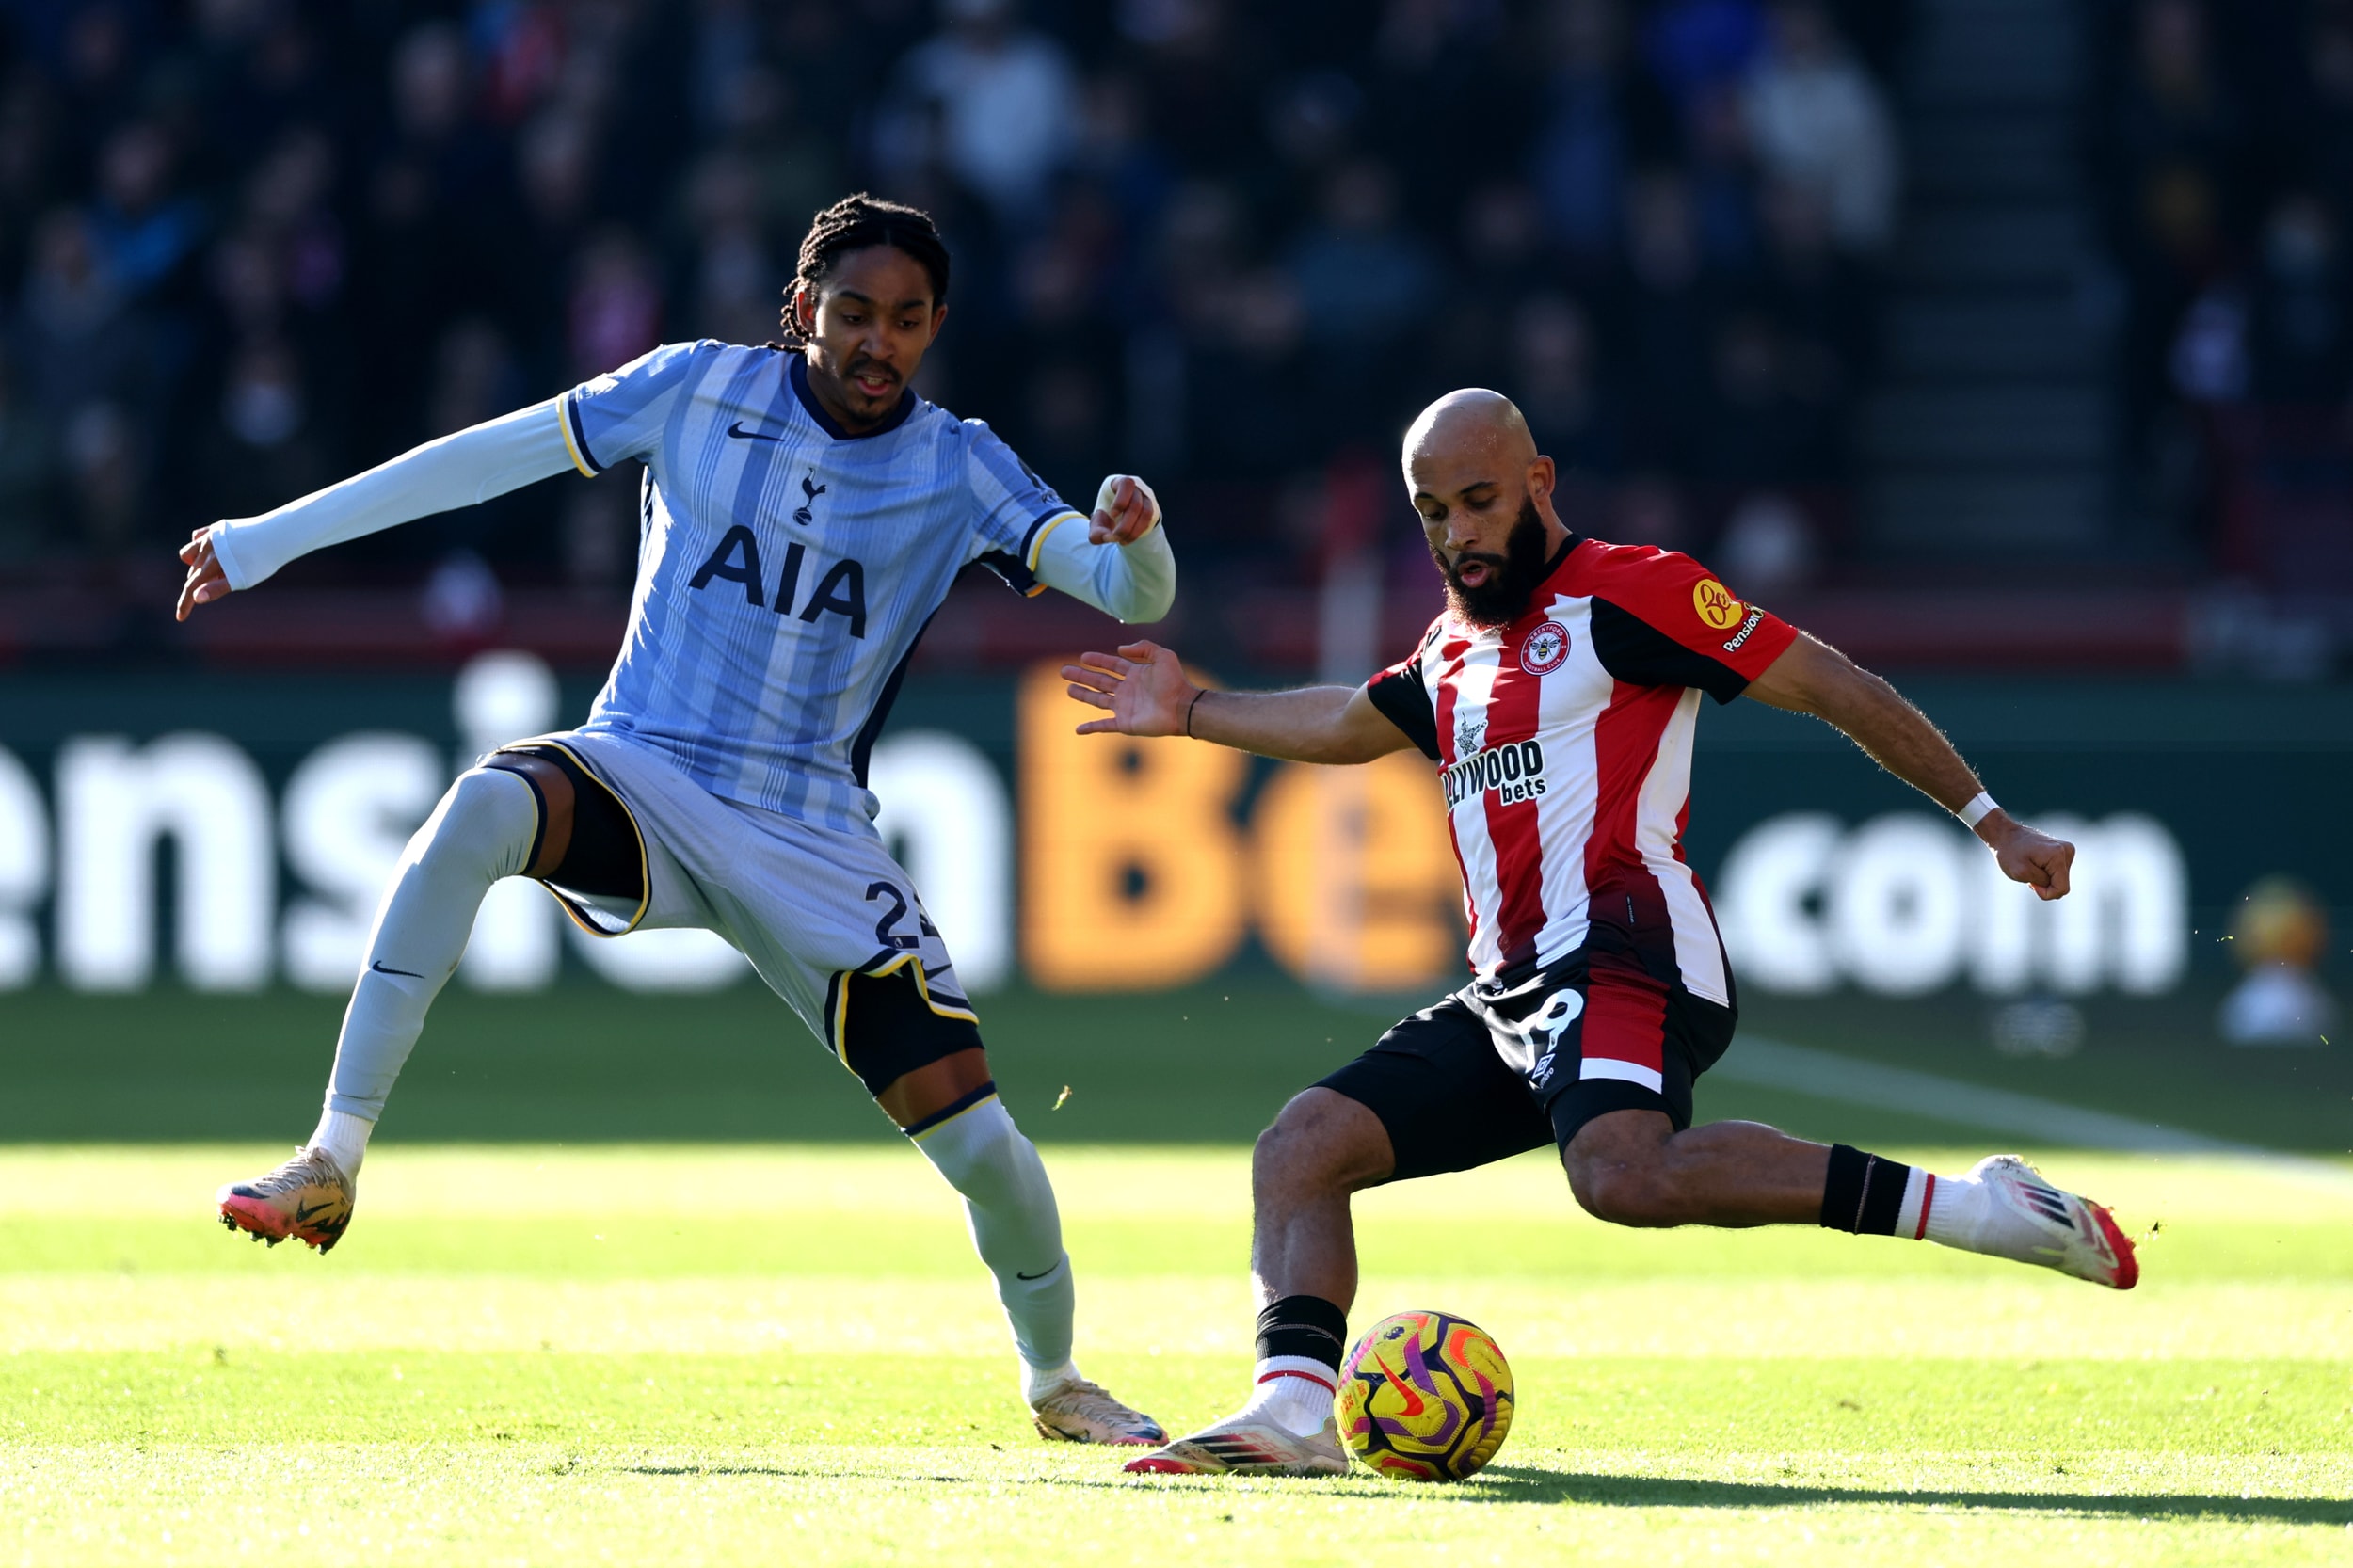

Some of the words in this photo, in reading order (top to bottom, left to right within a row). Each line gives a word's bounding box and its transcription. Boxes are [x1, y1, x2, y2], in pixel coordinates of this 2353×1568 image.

[688, 524, 867, 640] AIA
[1529, 625, 1563, 641] BRENTFORD
[1501, 778, 1546, 804] bets
